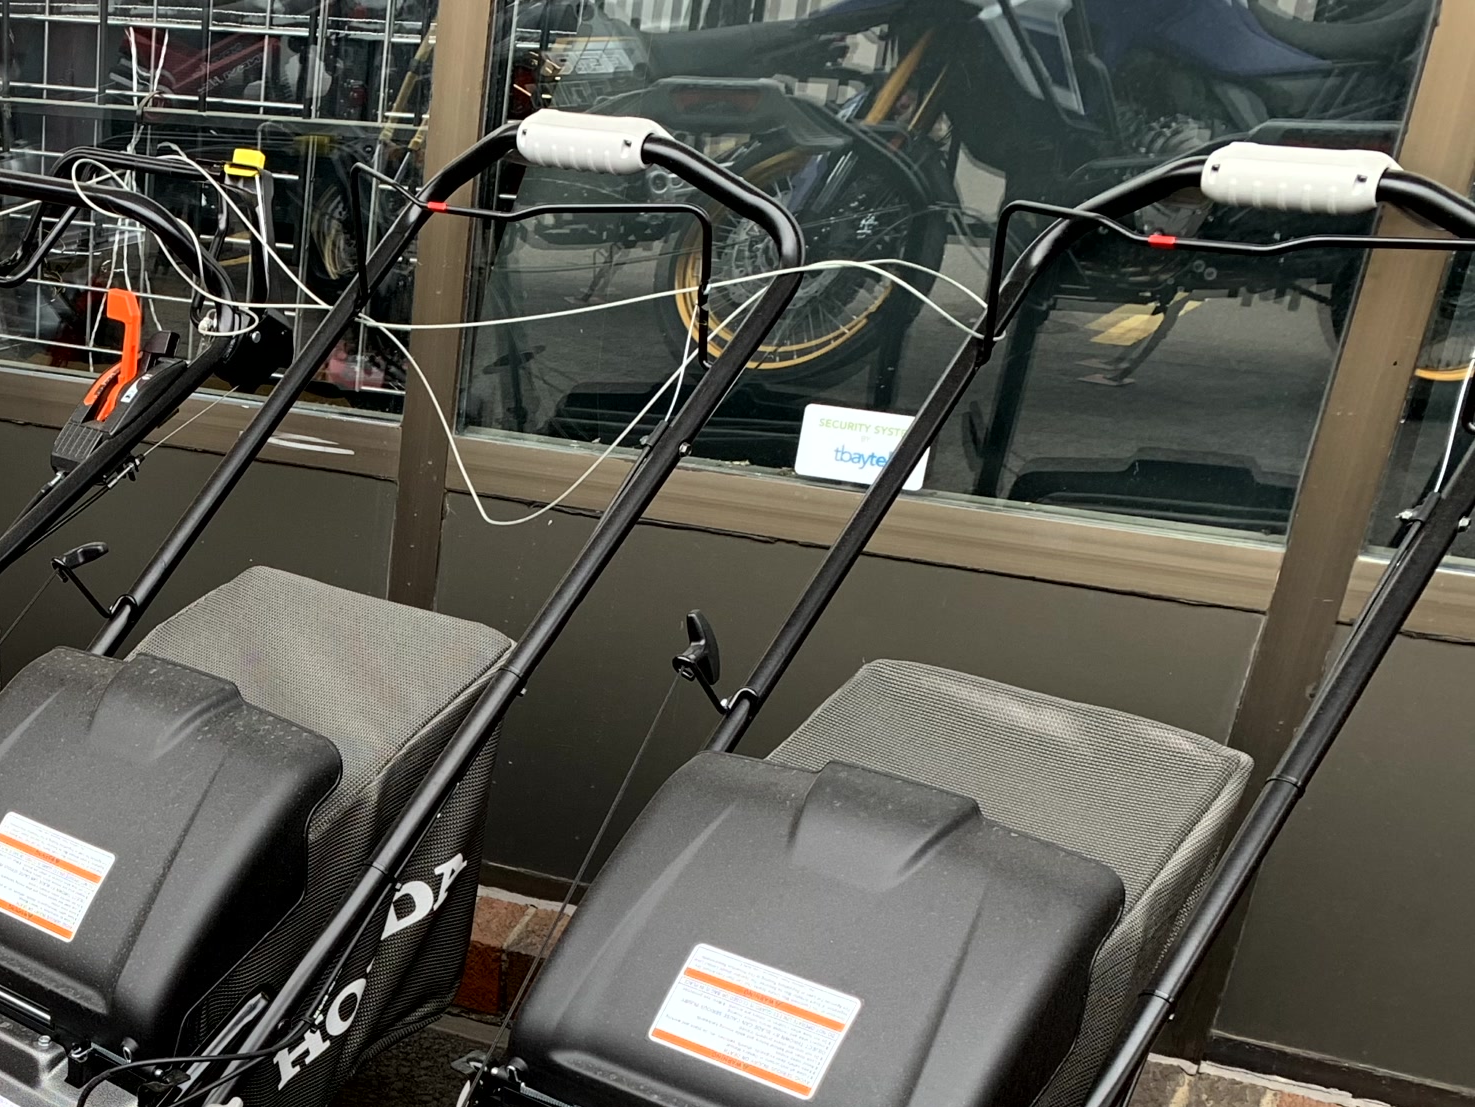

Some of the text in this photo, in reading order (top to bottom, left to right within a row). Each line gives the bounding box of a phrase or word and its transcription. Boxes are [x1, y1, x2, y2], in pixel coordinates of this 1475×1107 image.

[819, 418, 910, 438] SECURITY SYSTE
[273, 852, 468, 1092] HODA
